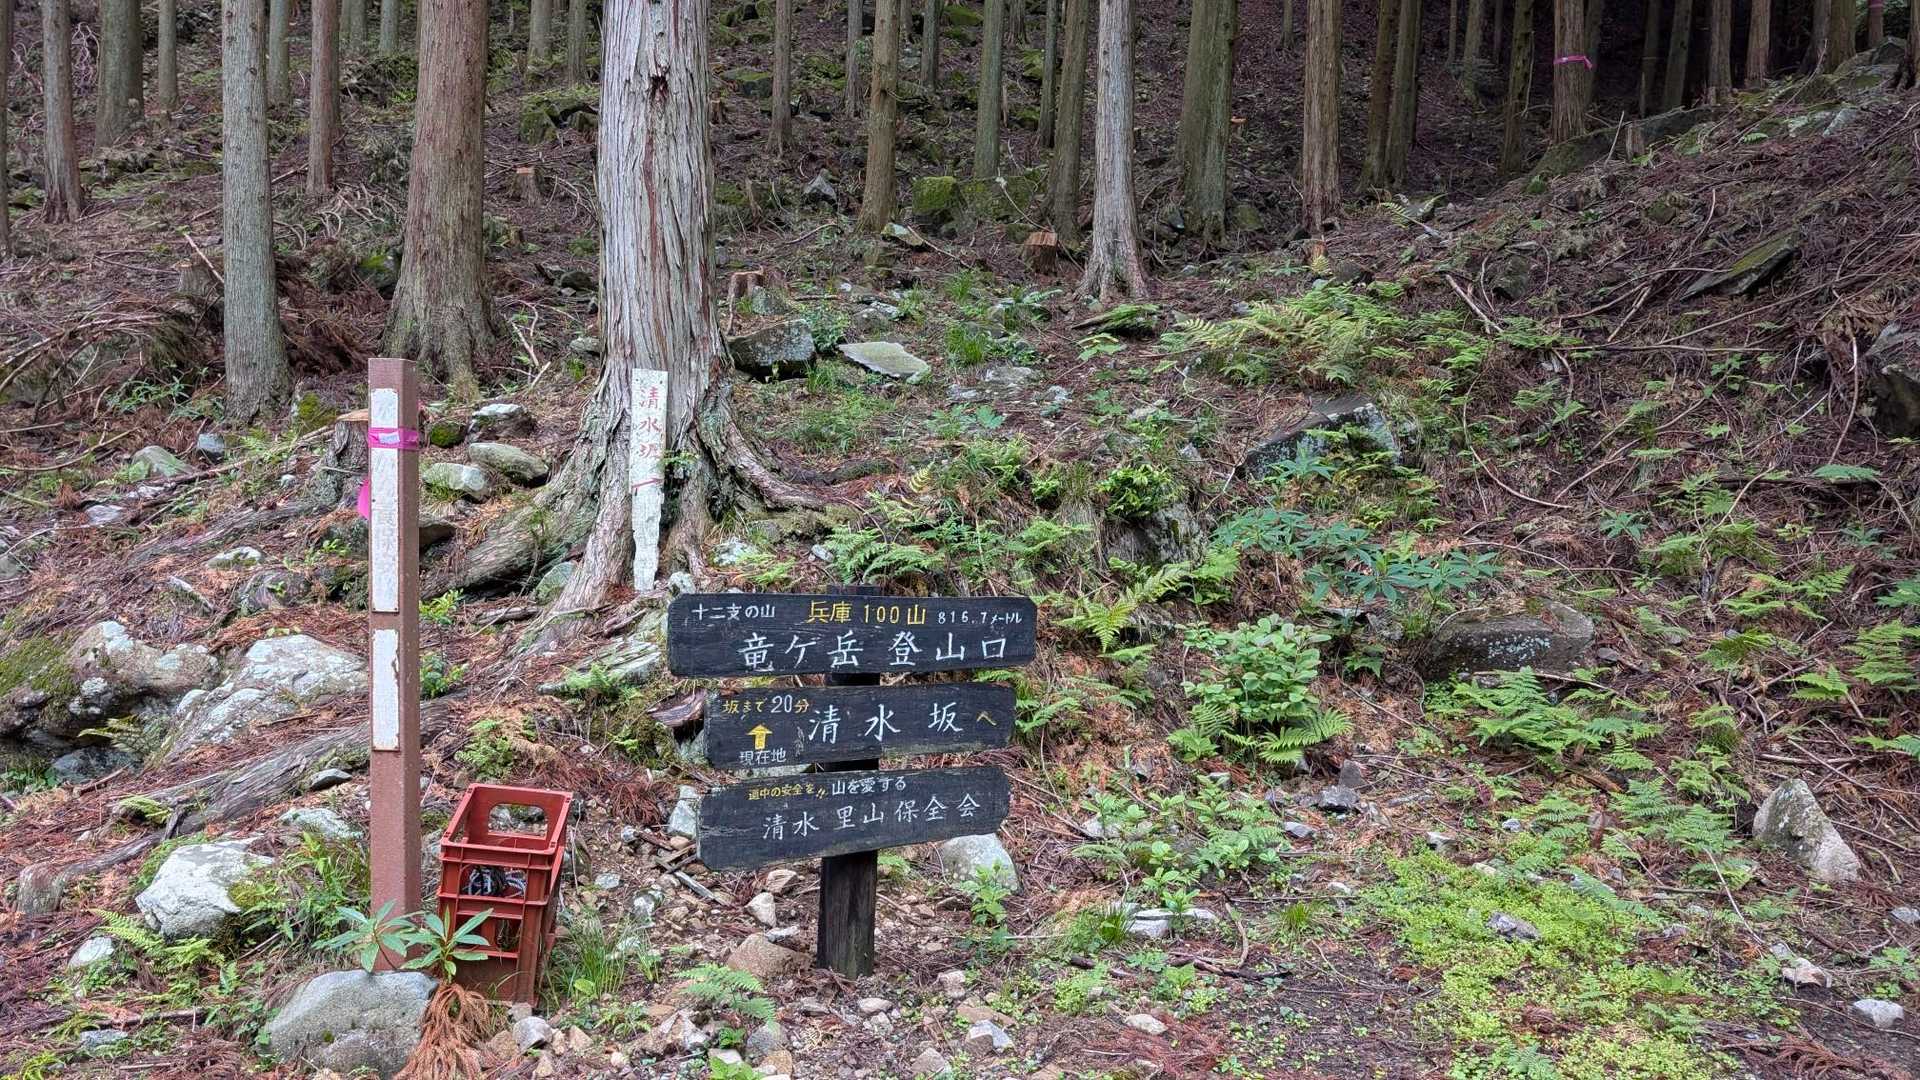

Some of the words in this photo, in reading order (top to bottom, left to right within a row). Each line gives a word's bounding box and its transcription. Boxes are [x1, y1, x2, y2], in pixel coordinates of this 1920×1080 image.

[691, 603, 776, 621] 十二支の山
[805, 601, 926, 625] 兵庫100山
[721, 694, 810, 714] 坂まで20分
[808, 703, 997, 744] 清水坂へ
[739, 747, 787, 766] 現在地
[832, 776, 907, 796] 山を愛する
